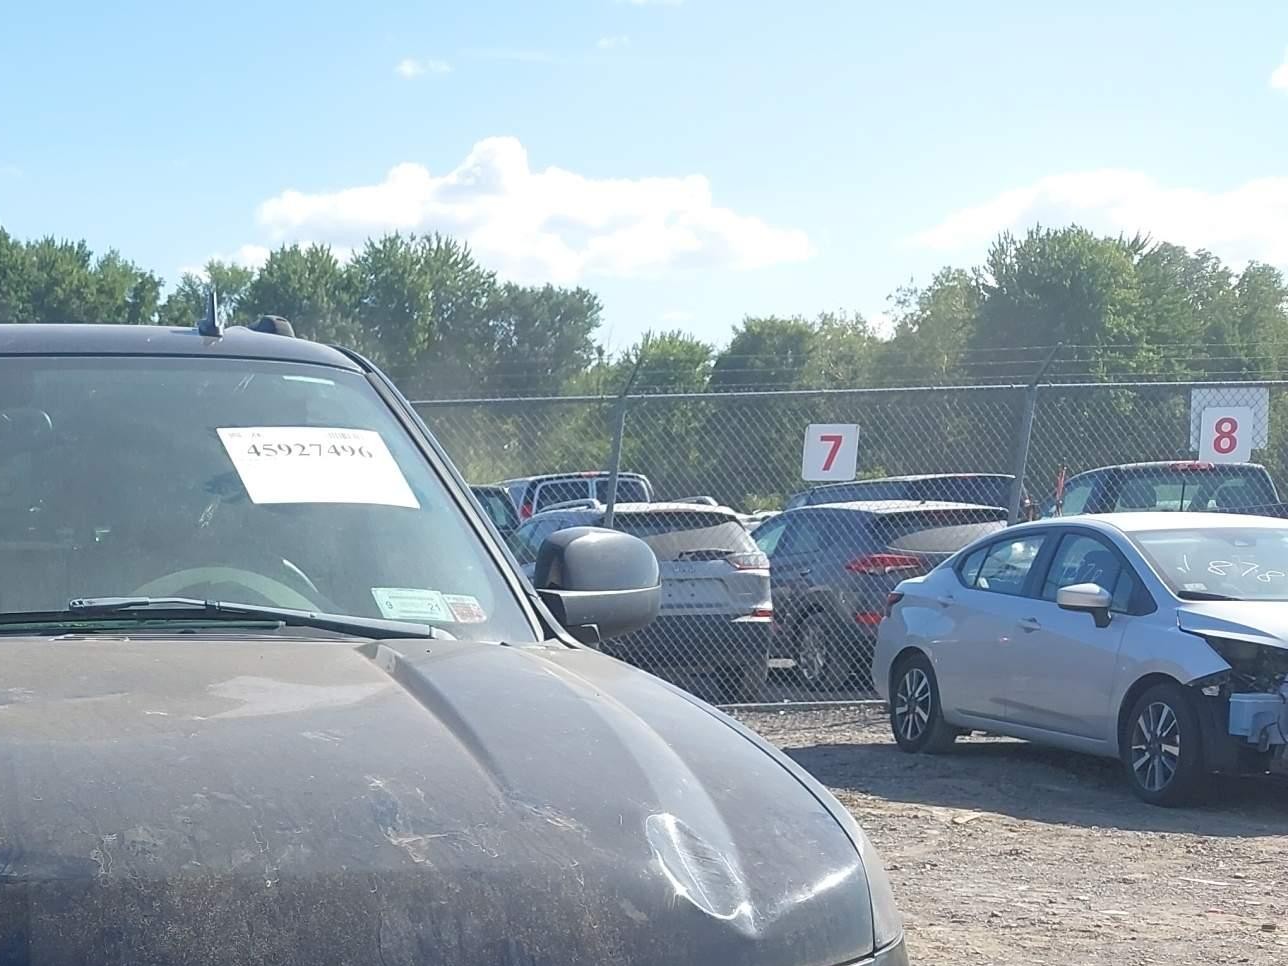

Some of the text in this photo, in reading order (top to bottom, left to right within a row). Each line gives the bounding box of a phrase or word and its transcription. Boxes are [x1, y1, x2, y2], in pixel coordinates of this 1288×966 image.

[247, 443, 373, 458] 45927496
[820, 435, 843, 471] 7
[1213, 417, 1238, 454] 8
